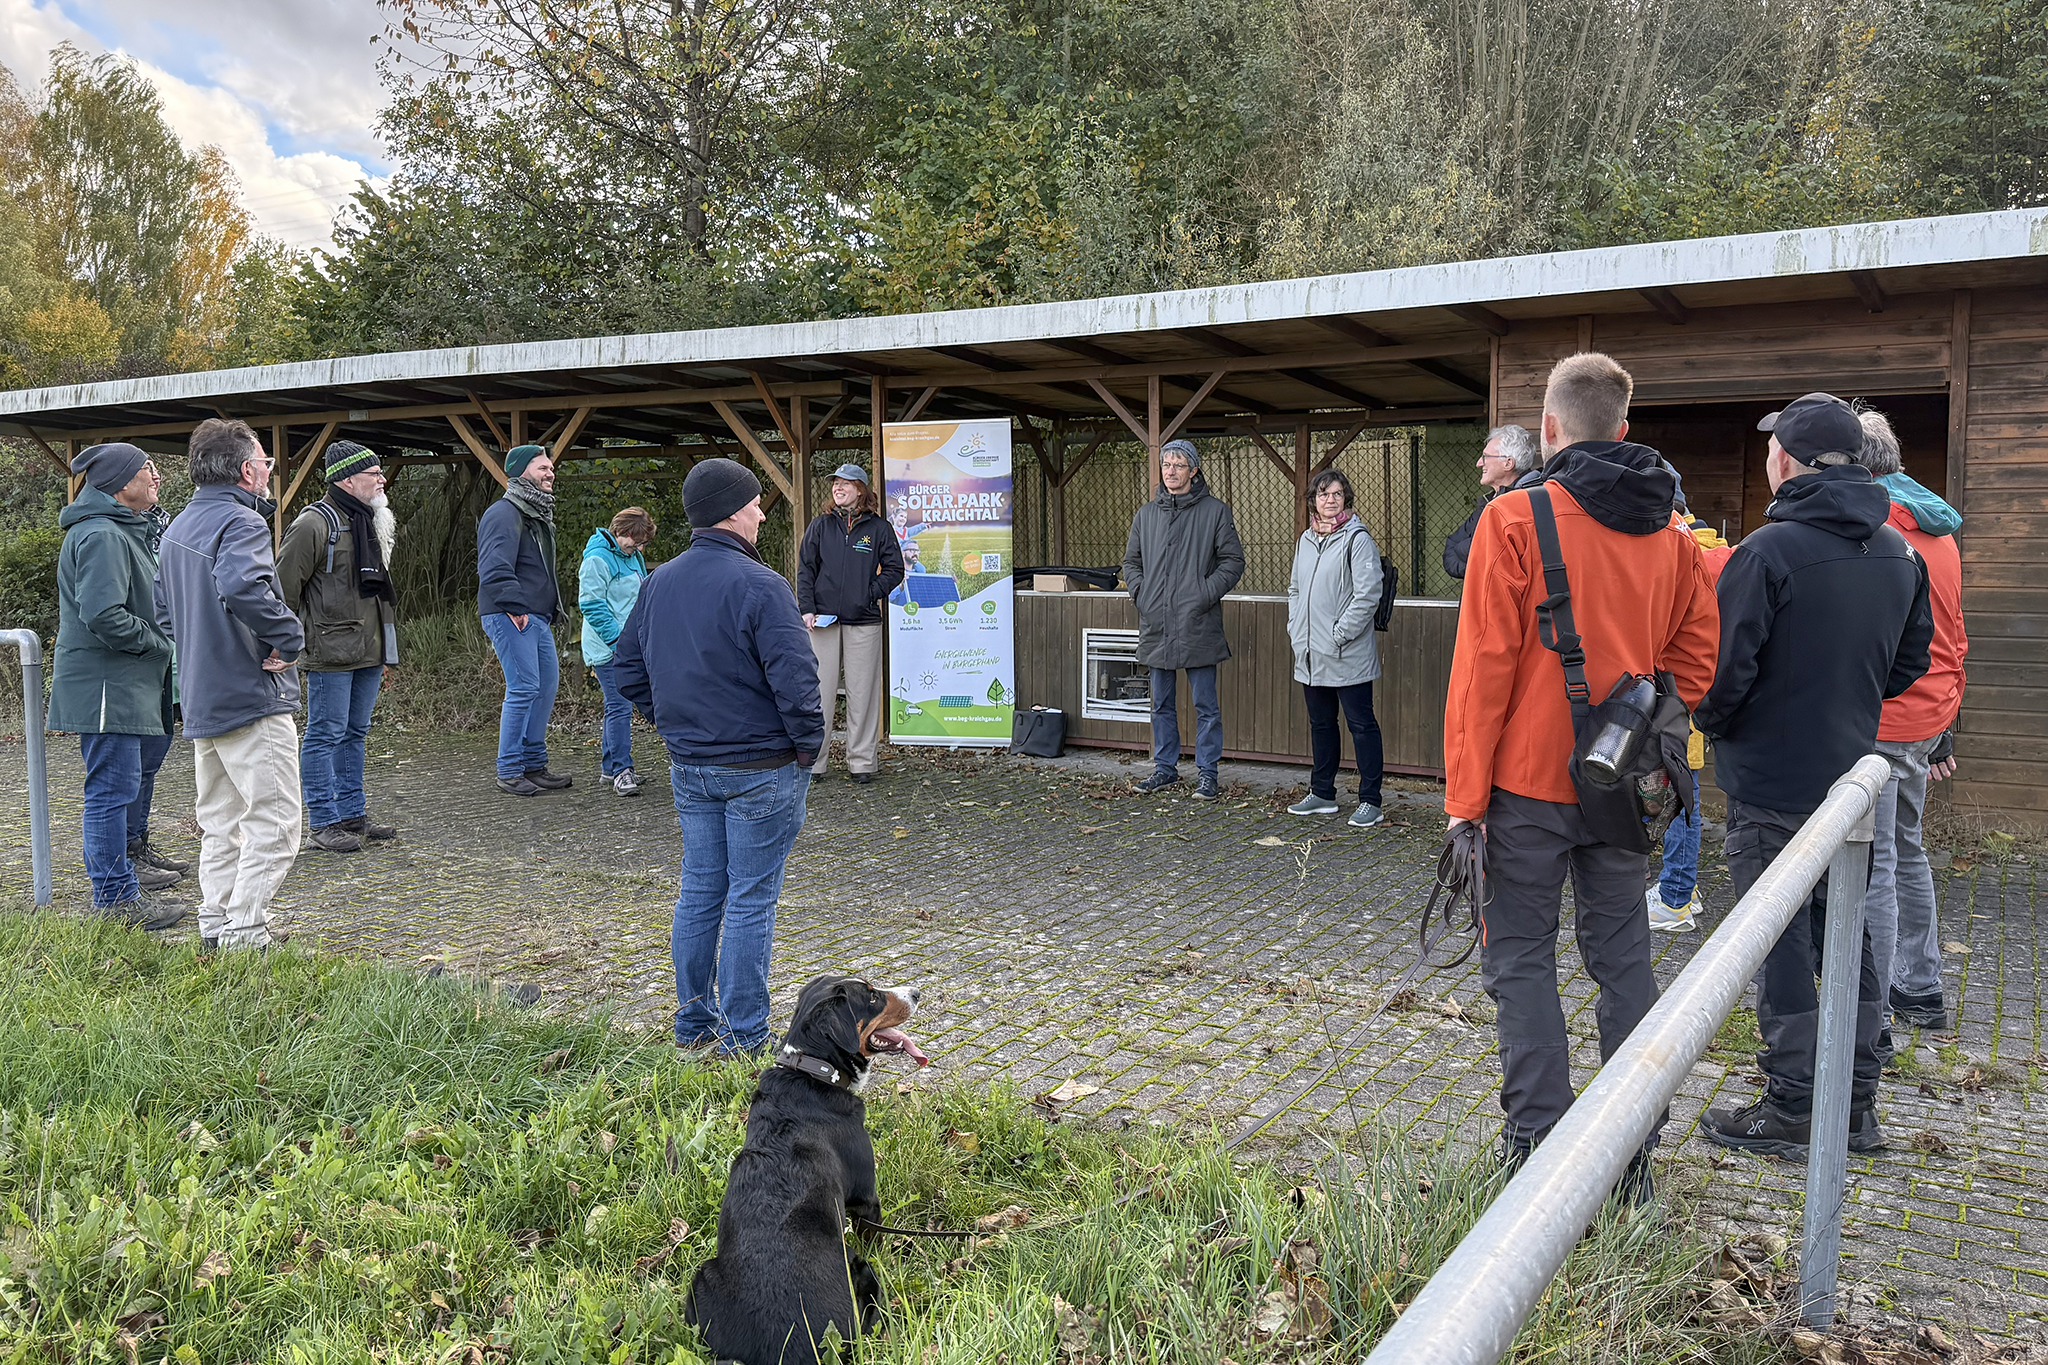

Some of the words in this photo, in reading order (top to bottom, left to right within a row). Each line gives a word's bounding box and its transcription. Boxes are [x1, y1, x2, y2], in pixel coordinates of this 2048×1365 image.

[909, 484, 950, 495] BÜRGER
[898, 493, 1003, 510] SOLAR.PARK
[922, 508, 1000, 522] KRAICHTAL
[943, 715, 1003, 723] www.beg-kraichgau.de
